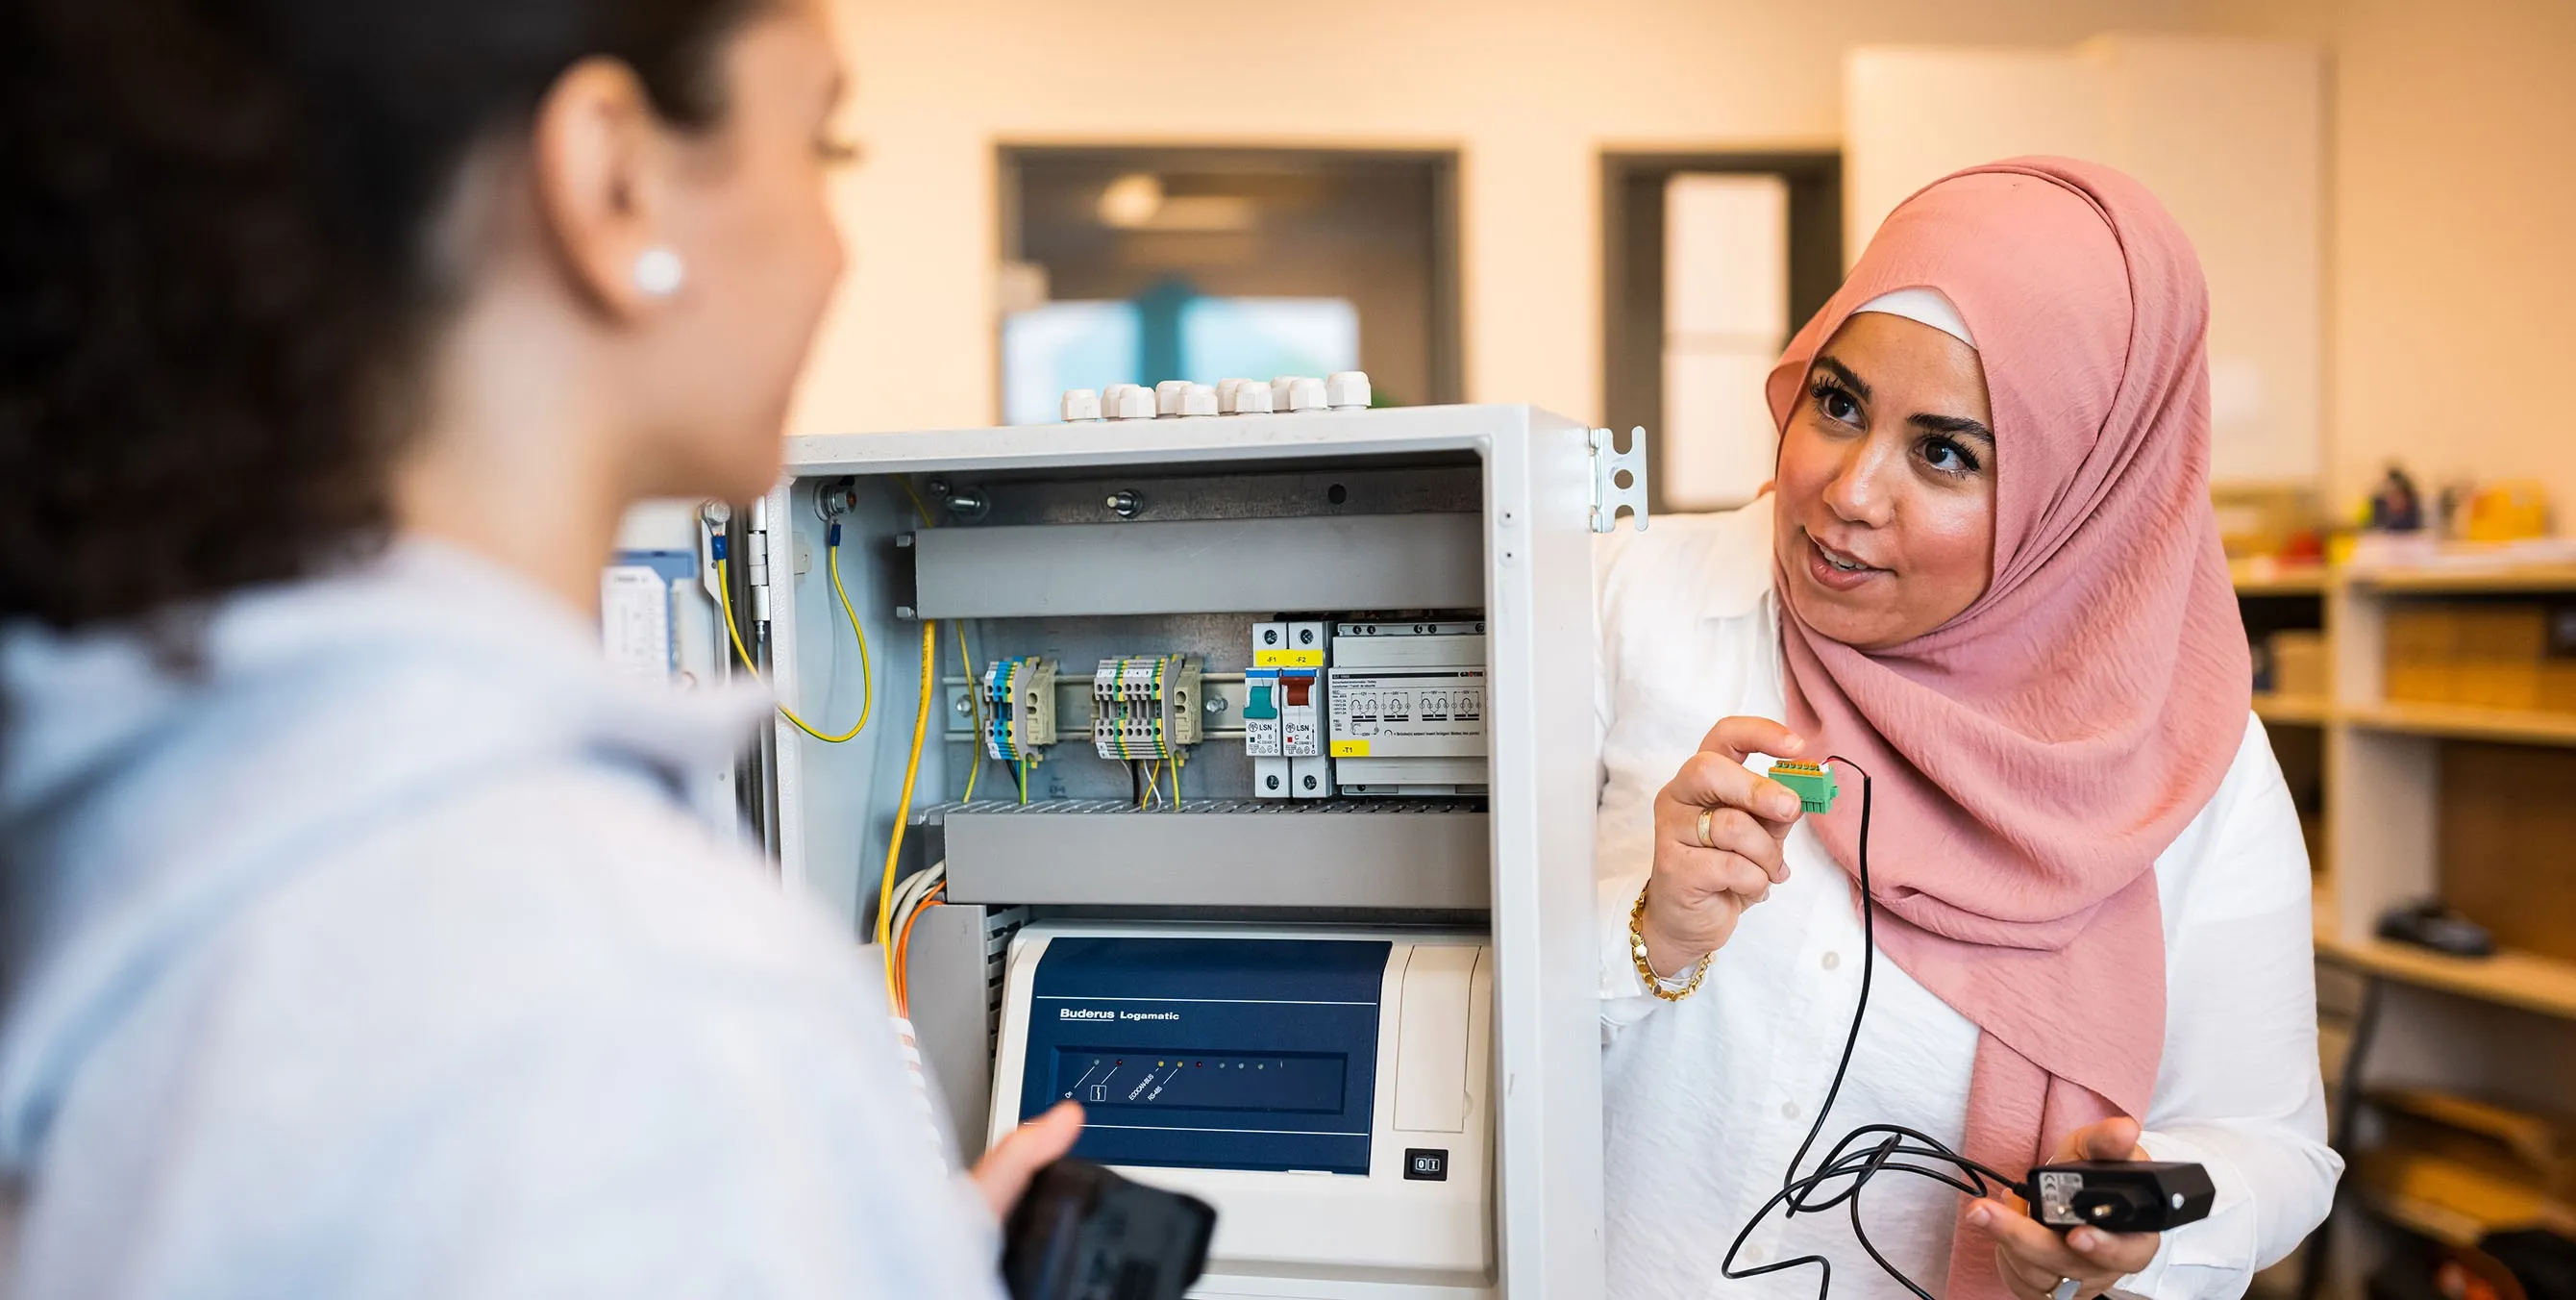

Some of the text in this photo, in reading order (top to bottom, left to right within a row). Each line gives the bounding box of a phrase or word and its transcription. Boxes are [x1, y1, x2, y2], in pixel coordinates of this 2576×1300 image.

[1060, 1008, 1179, 1021] Buderus Logamatic
[1127, 1073, 1154, 1101] ECOCAN-BUS
[1147, 1086, 1163, 1102] RS-485
